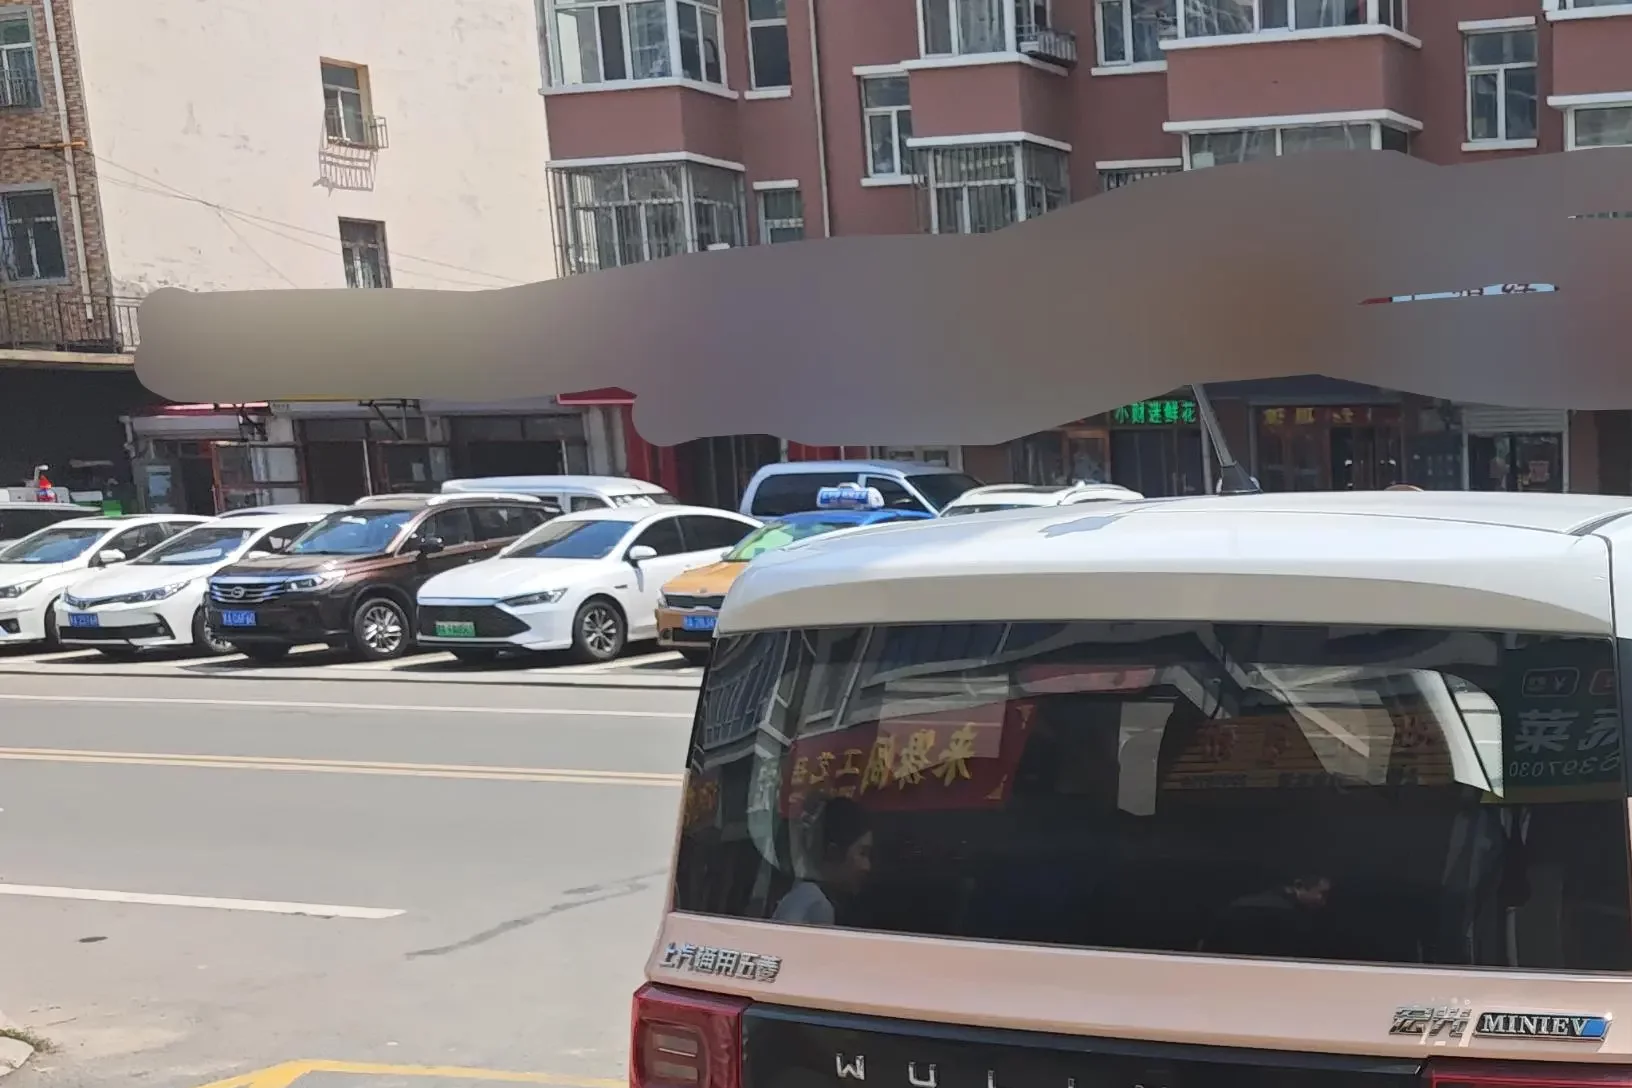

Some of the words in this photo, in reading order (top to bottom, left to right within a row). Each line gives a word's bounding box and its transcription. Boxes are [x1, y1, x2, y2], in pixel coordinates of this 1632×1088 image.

[661, 942, 782, 983] 上汽通用五菱
[1483, 1013, 1589, 1036] MINIEV
